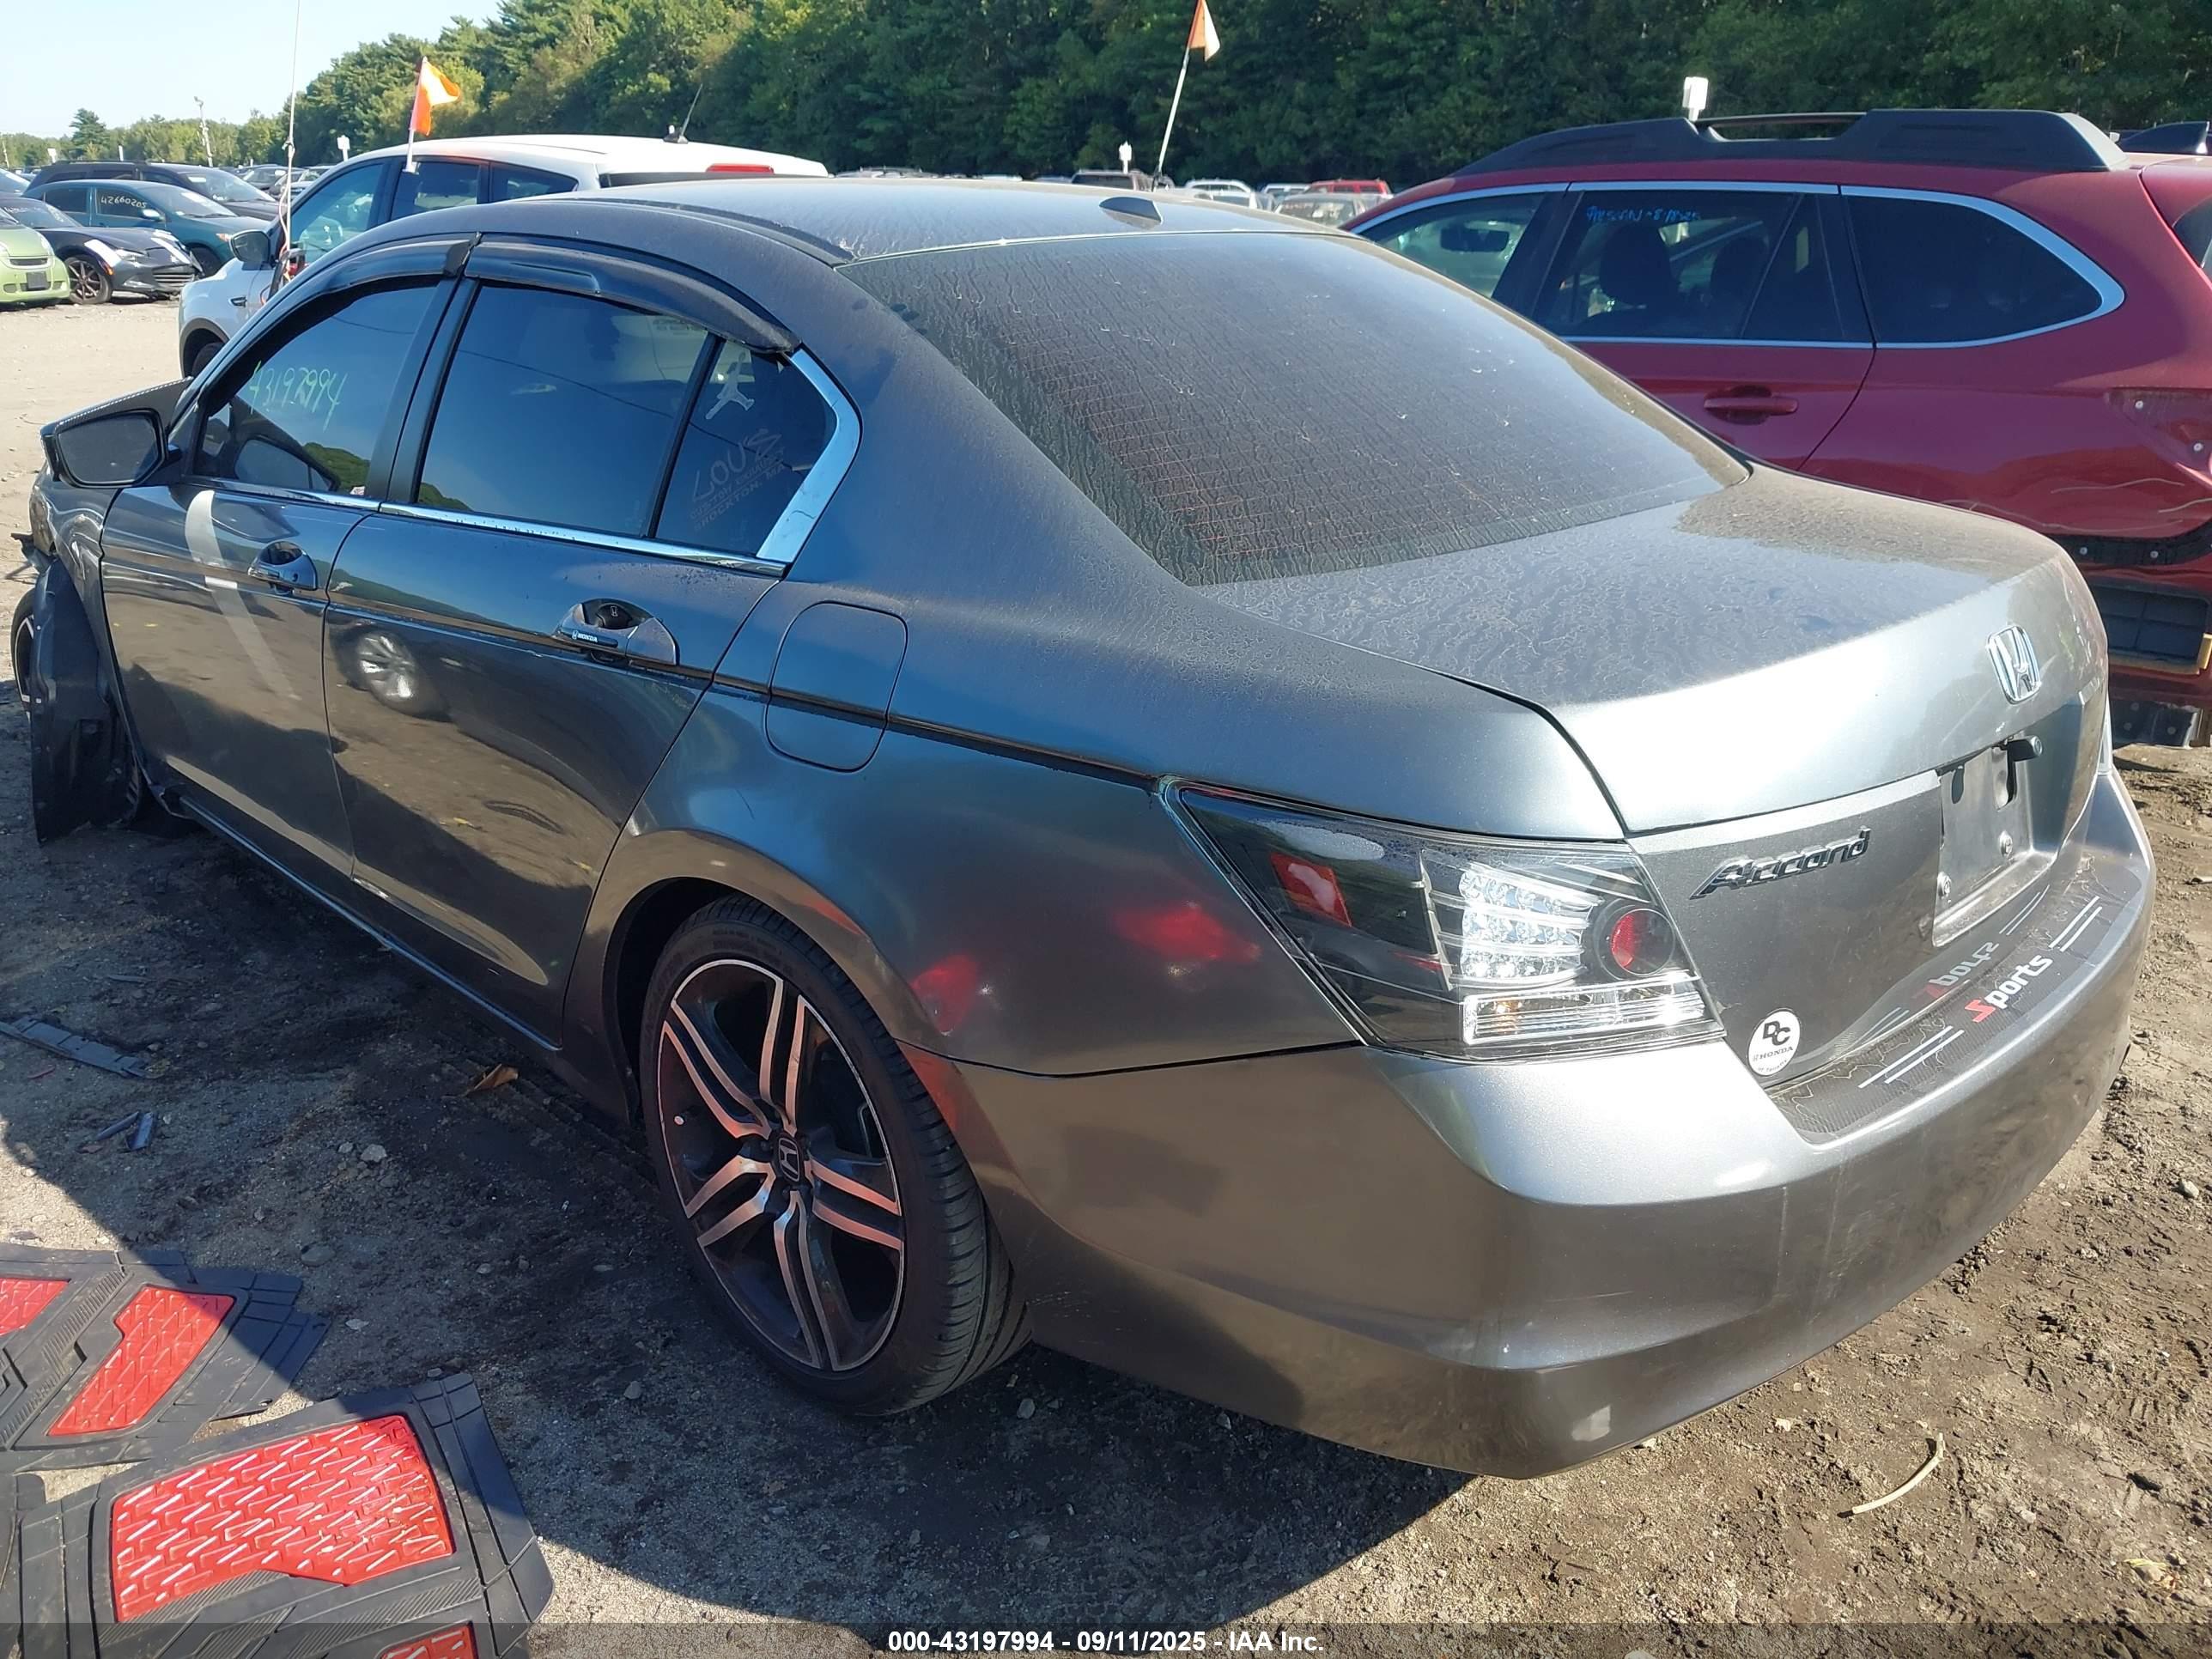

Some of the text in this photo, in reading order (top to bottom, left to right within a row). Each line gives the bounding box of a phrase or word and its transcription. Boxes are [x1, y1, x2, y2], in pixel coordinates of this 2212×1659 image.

[1689, 824, 1872, 901] Accord
[1965, 954, 2054, 1023] Sports
[1759, 1045, 1794, 1060] HONDA
